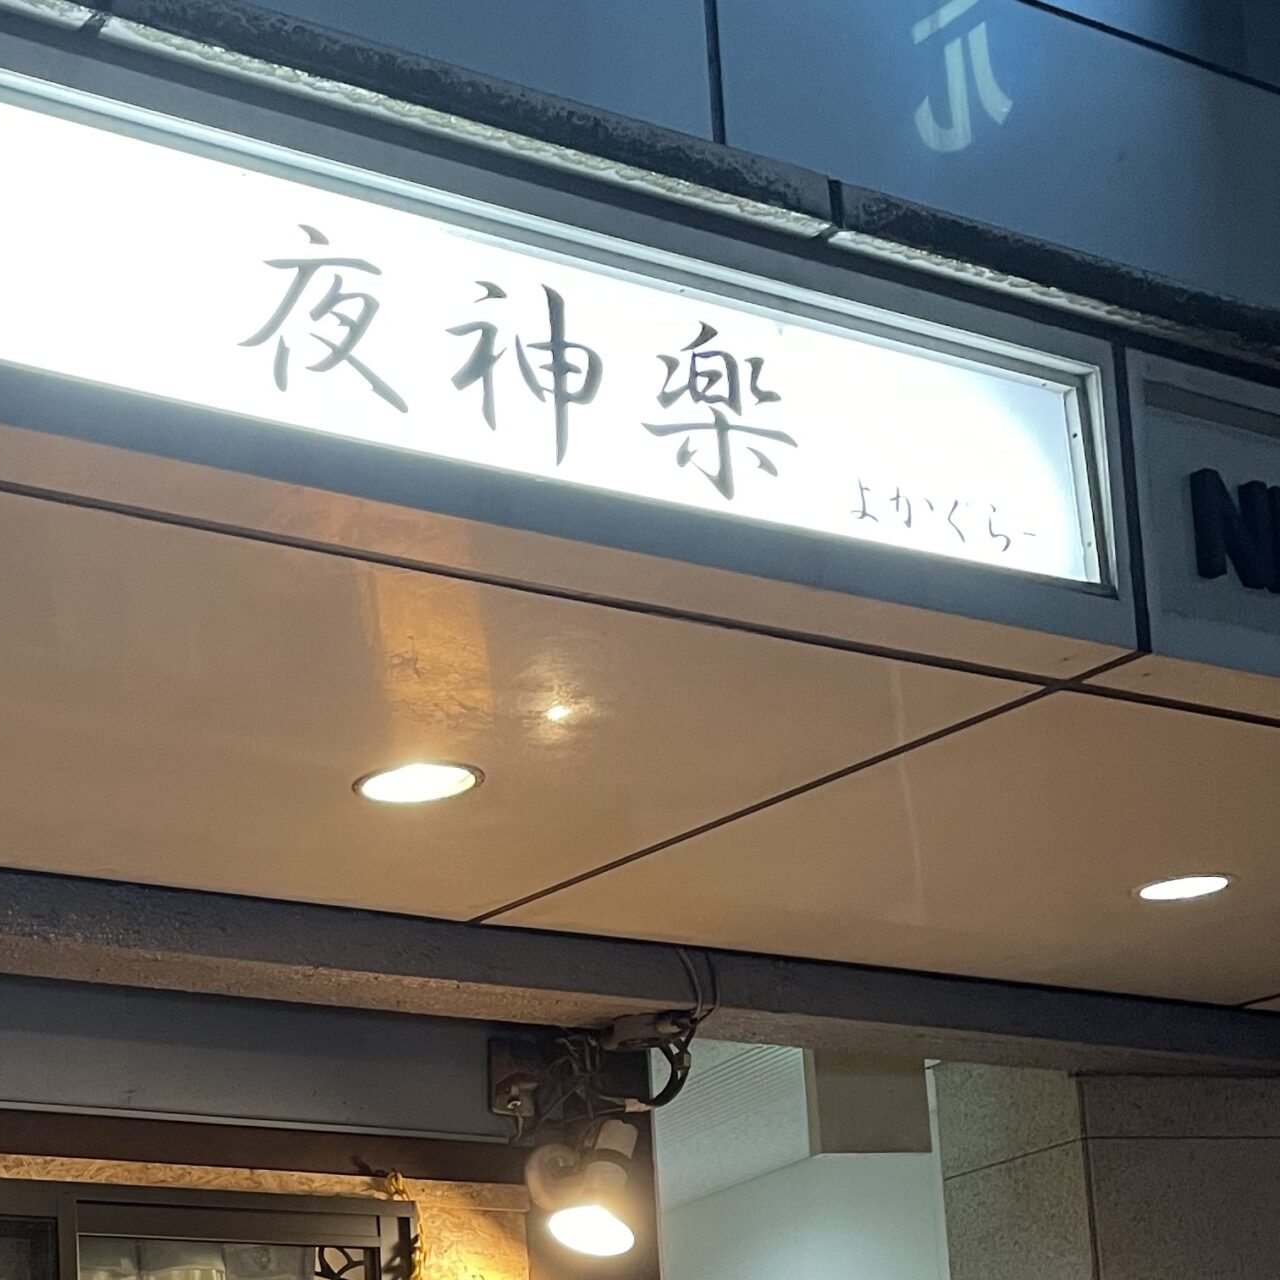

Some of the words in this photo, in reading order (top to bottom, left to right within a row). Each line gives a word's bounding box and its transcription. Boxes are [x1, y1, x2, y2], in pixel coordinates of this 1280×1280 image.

[238, 223, 798, 502] 夜神楽
[1189, 467, 1280, 594] N
